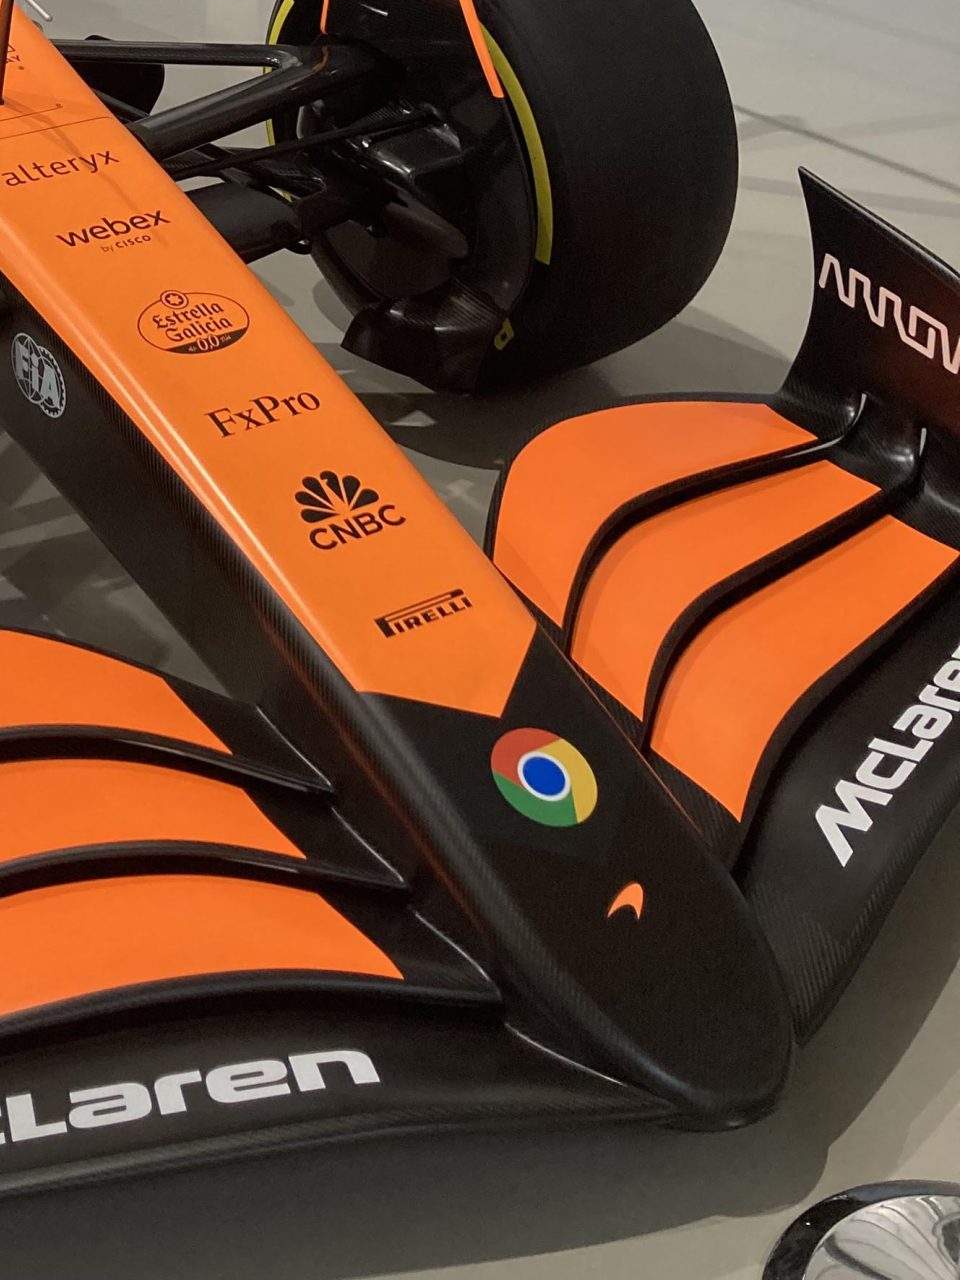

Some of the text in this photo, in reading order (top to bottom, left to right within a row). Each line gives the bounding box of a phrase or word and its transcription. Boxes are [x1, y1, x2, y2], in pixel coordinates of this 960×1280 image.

[1, 150, 120, 187] alteryx
[55, 209, 172, 247] webex
[152, 303, 224, 329] Estrella
[165, 317, 233, 342] Galicia
[203, 391, 321, 438] FxPro
[309, 504, 406, 551] CNBC
[374, 588, 473, 638] PIRELLI
[815, 644, 960, 868] McLare
